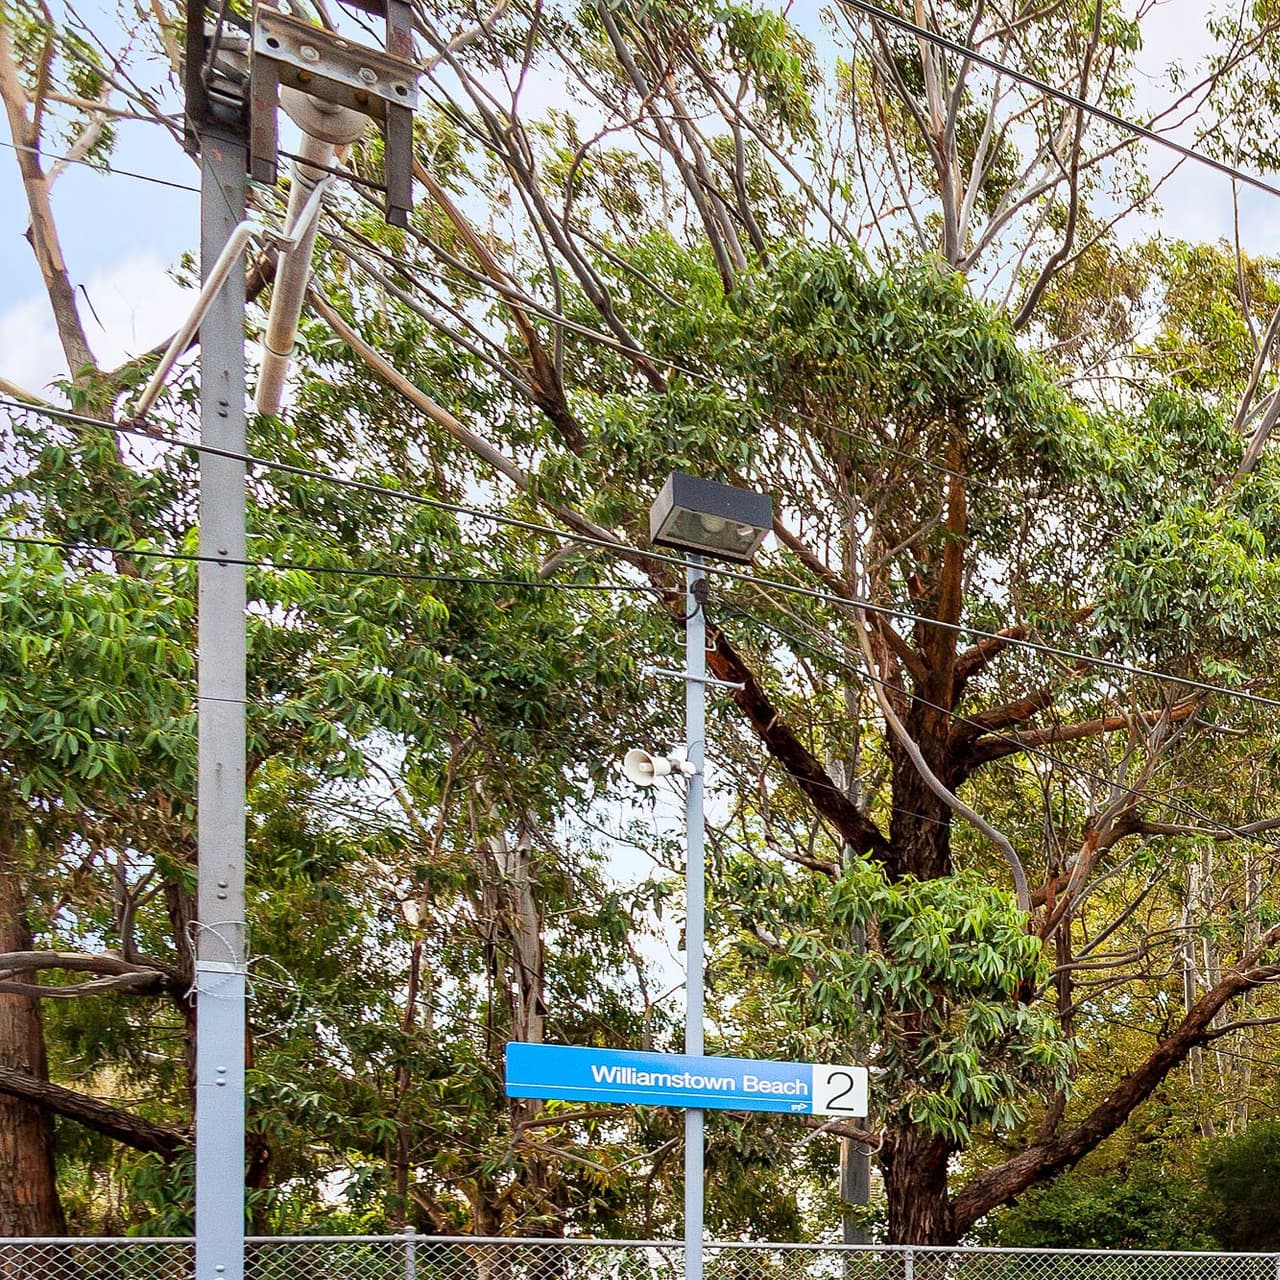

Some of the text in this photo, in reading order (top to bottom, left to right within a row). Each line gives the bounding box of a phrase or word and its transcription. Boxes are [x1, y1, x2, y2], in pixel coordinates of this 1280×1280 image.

[591, 1065, 855, 1112] Williamstown Beach 2
